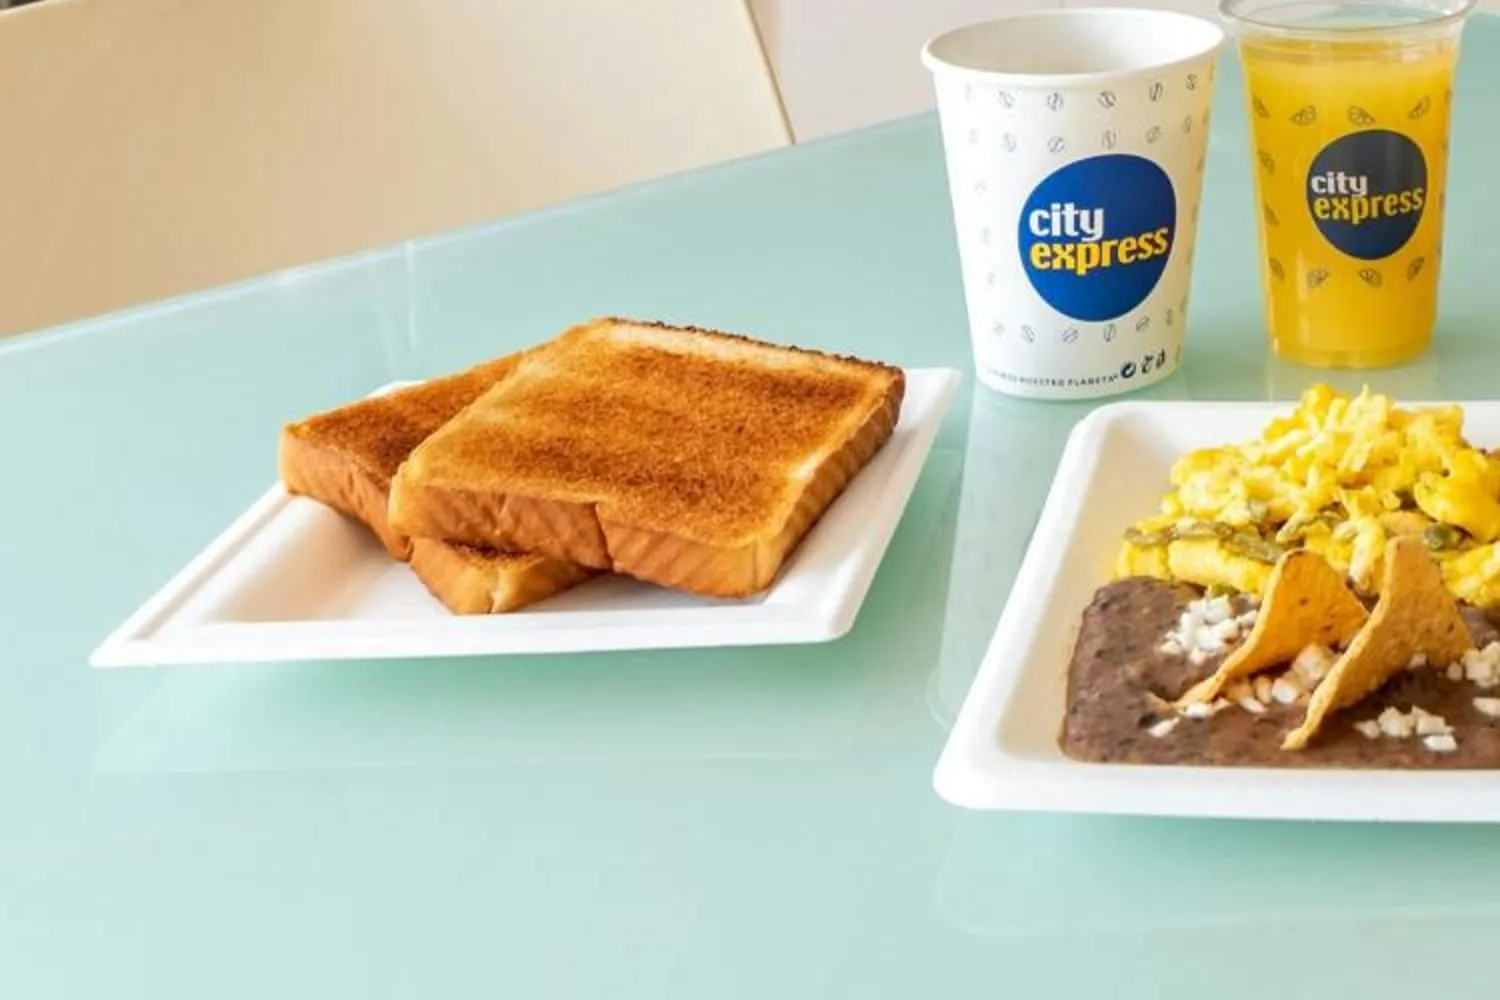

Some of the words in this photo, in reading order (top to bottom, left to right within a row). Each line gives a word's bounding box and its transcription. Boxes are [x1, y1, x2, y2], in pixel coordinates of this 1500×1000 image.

[1310, 171, 1368, 198] city
[1029, 202, 1104, 242] city
[1314, 187, 1424, 225] express
[1030, 227, 1169, 276] express
